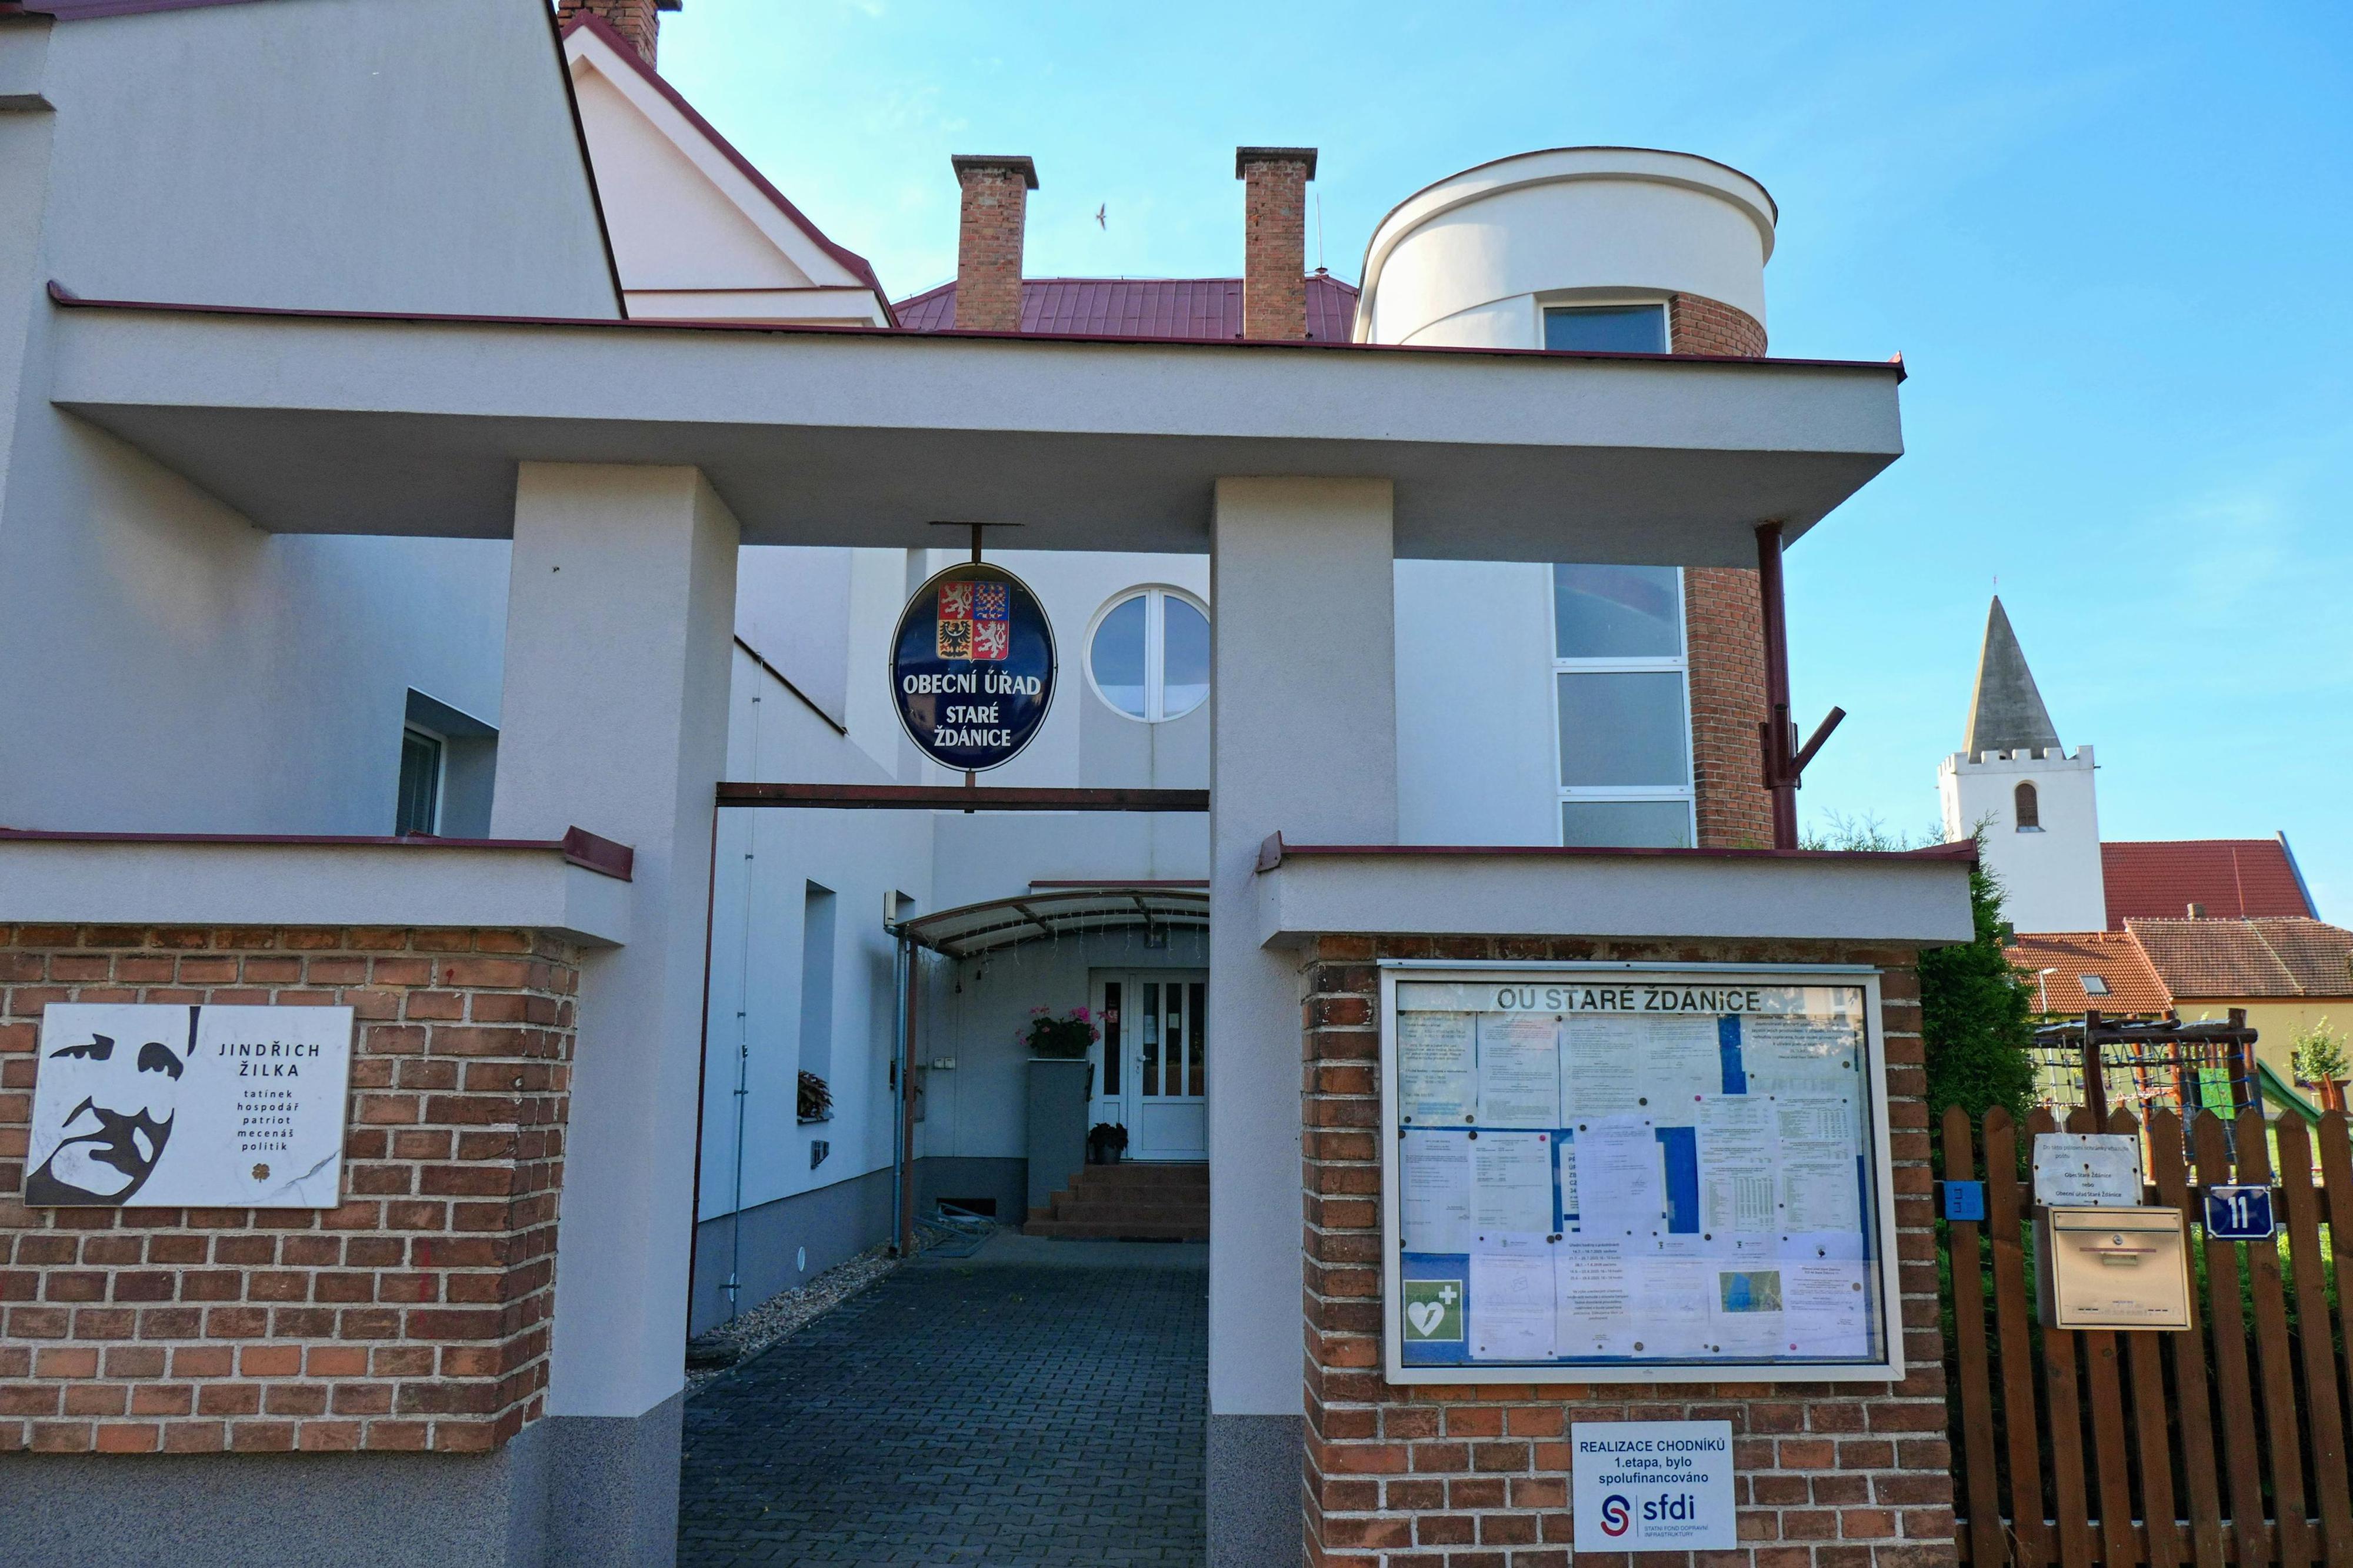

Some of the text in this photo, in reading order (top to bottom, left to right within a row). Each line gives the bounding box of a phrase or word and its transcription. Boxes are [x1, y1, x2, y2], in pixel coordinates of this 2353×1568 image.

[903, 668, 1041, 695] OBECNÍ ÚŘAD
[946, 702, 999, 723] STARÉ
[934, 725, 1011, 746] ŽDÁNICE
[1545, 985, 1635, 1010] STARÉ
[1644, 985, 1761, 1012] ŽDÁNICE
[219, 1041, 319, 1057] JINDŘICH
[239, 1061, 299, 1076] ŽILKA
[244, 1090, 292, 1098] tatínek
[238, 1103, 299, 1112] hospodář
[243, 1116, 291, 1126] patriot
[238, 1129, 294, 1137] mecenáš
[242, 1143, 287, 1152] politik
[2228, 1196, 2248, 1228] 11
[1580, 1437, 1725, 1452] REALIZACE CHODNÍKŮ
[1615, 1456, 1692, 1469] 1.etapa, bylo
[1599, 1472, 1708, 1486] spolufinancováno
[1644, 1493, 1694, 1520] sfdi
